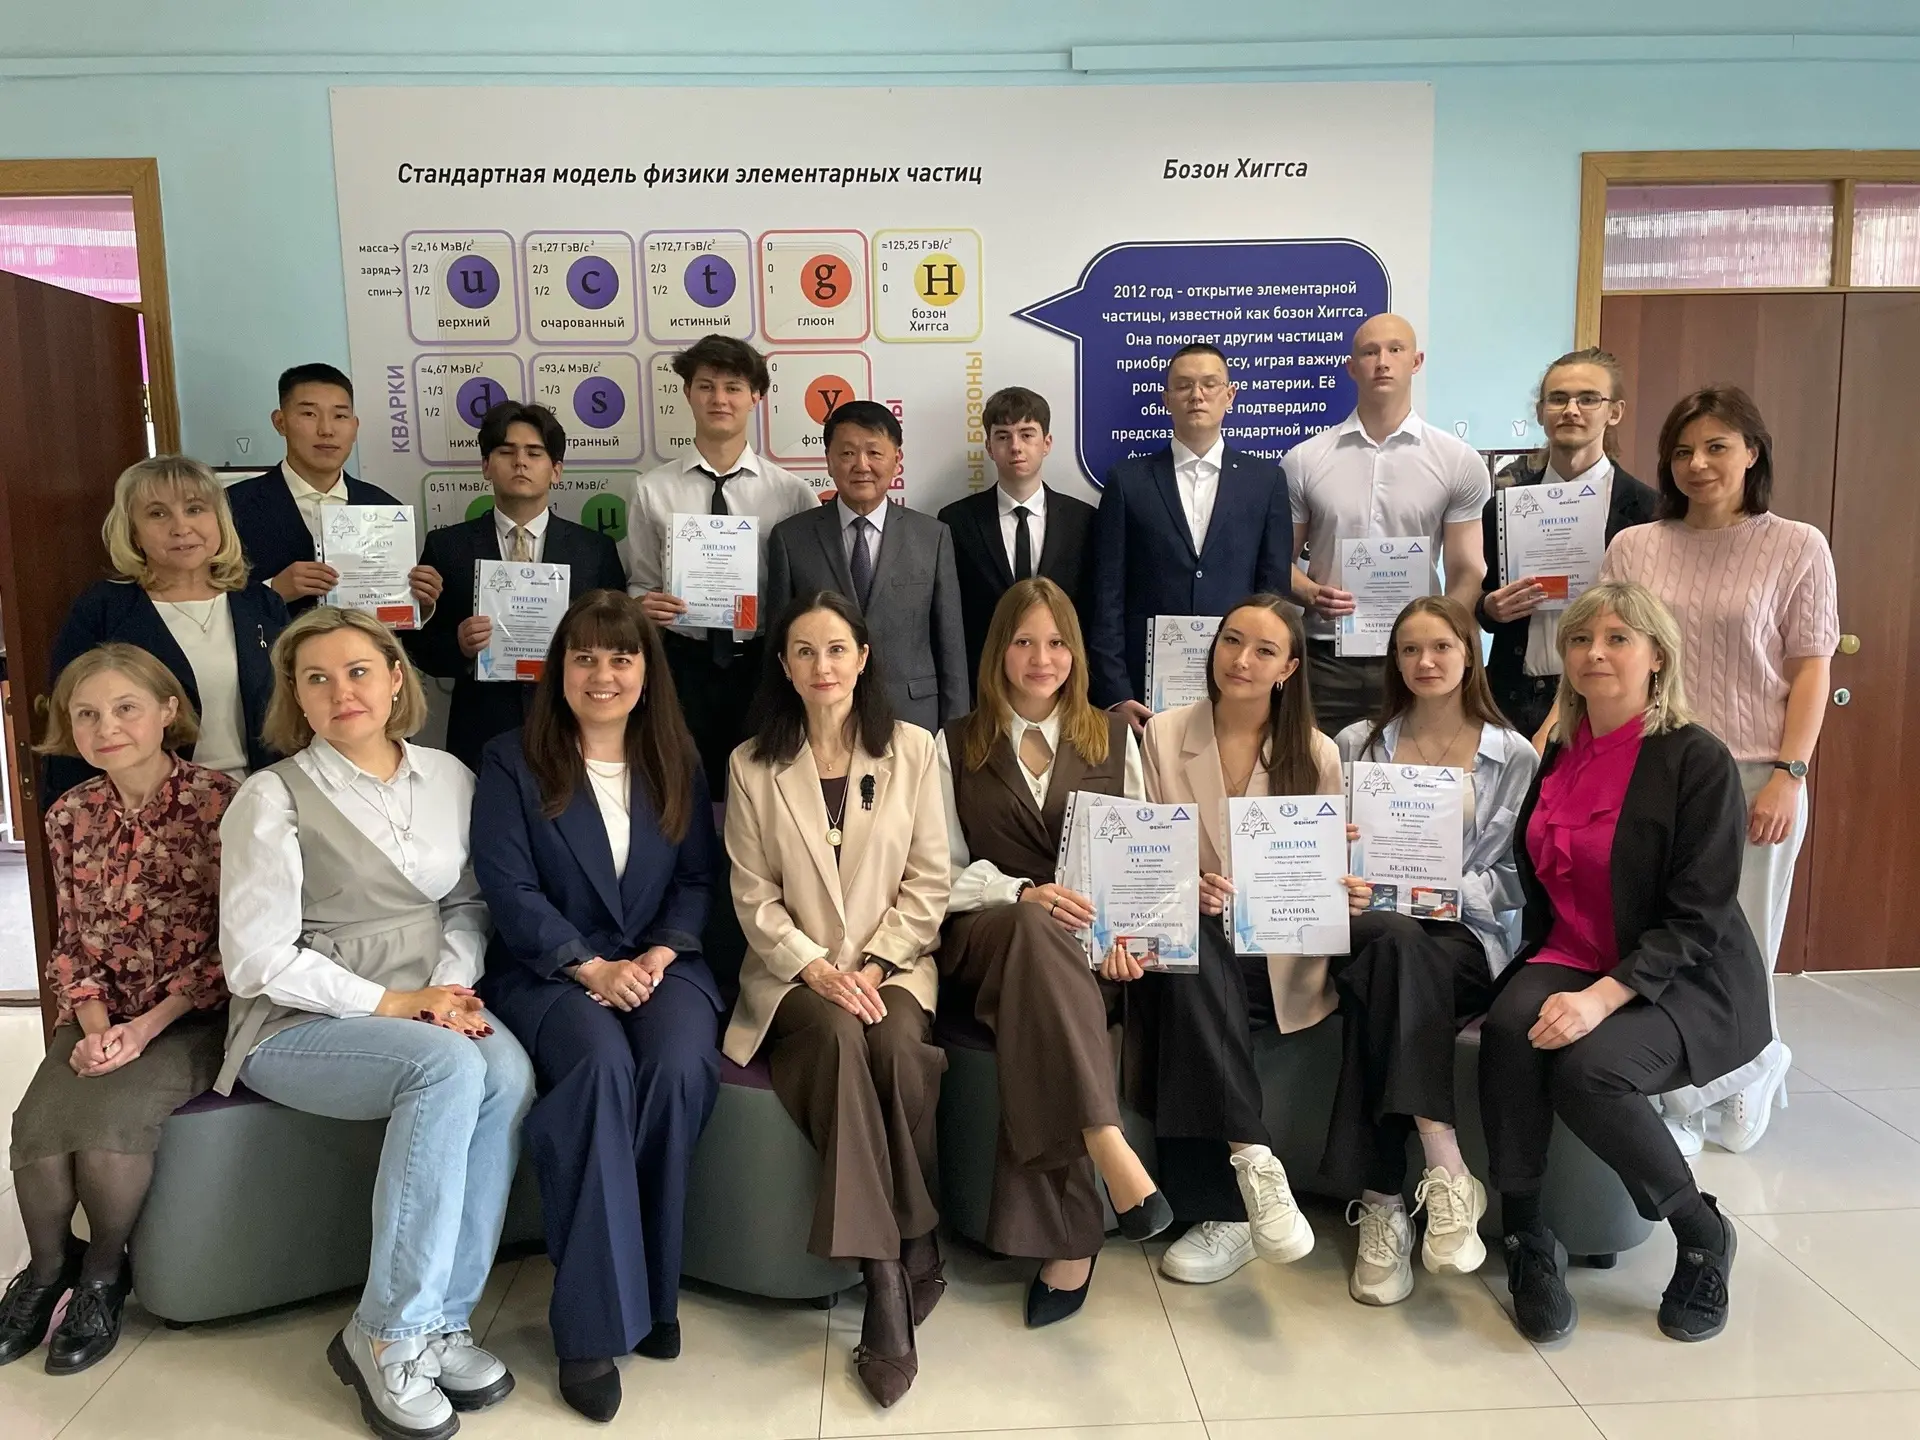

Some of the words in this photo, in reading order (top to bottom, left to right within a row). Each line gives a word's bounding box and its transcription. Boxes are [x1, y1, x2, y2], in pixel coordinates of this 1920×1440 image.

[1163, 159, 1229, 179] Бозон
[1234, 158, 1308, 178] Хиггса
[398, 163, 546, 188] Стандартная
[552, 167, 637, 186] модель
[643, 163, 729, 188] физики
[735, 166, 900, 187] элементарных
[906, 165, 982, 184] частиц
[359, 245, 389, 254] масса
[361, 267, 391, 276] заряд
[413, 264, 429, 274] 2/3
[533, 264, 549, 274] 2/3
[651, 263, 667, 274] 2/3
[460, 268, 487, 294] u
[581, 270, 601, 294] c
[702, 265, 718, 295] t
[814, 264, 837, 300] g
[923, 264, 958, 296] H
[368, 289, 393, 298] спин
[415, 286, 431, 296] 1/2
[535, 286, 550, 296] 1/2
[653, 285, 668, 295] 1/2
[1114, 285, 1147, 298] 2012
[1150, 287, 1173, 300] год
[1187, 286, 1253, 299] открытие
[1257, 281, 1357, 298] элементарной
[912, 307, 946, 319] бозон
[1102, 310, 1166, 324] частицы,
[1170, 306, 1243, 321] известной
[1246, 308, 1269, 320] как
[1273, 306, 1314, 319] бозон
[1318, 305, 1368, 318] Хиггса.
[438, 316, 490, 328] верхний
[541, 316, 625, 328] очарованный
[670, 315, 731, 327] истинный
[798, 316, 835, 327] глюон
[909, 320, 949, 332] Хиггса
[1126, 333, 1152, 346] Она
[1157, 333, 1221, 345] помогает
[1224, 332, 1273, 347] другим
[1277, 331, 1343, 343] частицам
[1254, 355, 1294, 368] играя
[1298, 354, 1352, 367] важную
[422, 386, 443, 396] -1/3
[540, 385, 560, 395] -1/3
[658, 385, 678, 394] -1/3
[1132, 382, 1165, 395] роль
[1252, 379, 1315, 393] материи.
[1319, 376, 1336, 388] Её
[591, 390, 608, 414] s
[966, 352, 984, 443] БОЗОНЫ
[387, 365, 411, 453] КВАРКИ
[424, 407, 440, 417] 1/2
[660, 405, 675, 415] 1/2
[1237, 401, 1327, 415] подтвердило
[1221, 423, 1301, 438] тандартной
[566, 436, 619, 449] транный
[430, 482, 456, 494] 0,511
[431, 504, 441, 512] -1
[1538, 516, 1579, 527] ДИПЛОМ
[1370, 570, 1407, 579] ДИПЛОМ
[1181, 647, 1209, 655] ДИПЛО
[1389, 800, 1435, 811] ДИПЛОМ
[1126, 845, 1171, 855] ДИПЛОМ
[1269, 840, 1317, 851] ДИПЛОМ
[1389, 864, 1428, 873] БЕЛКИНА
[1271, 907, 1316, 915] БАРАНОВА
